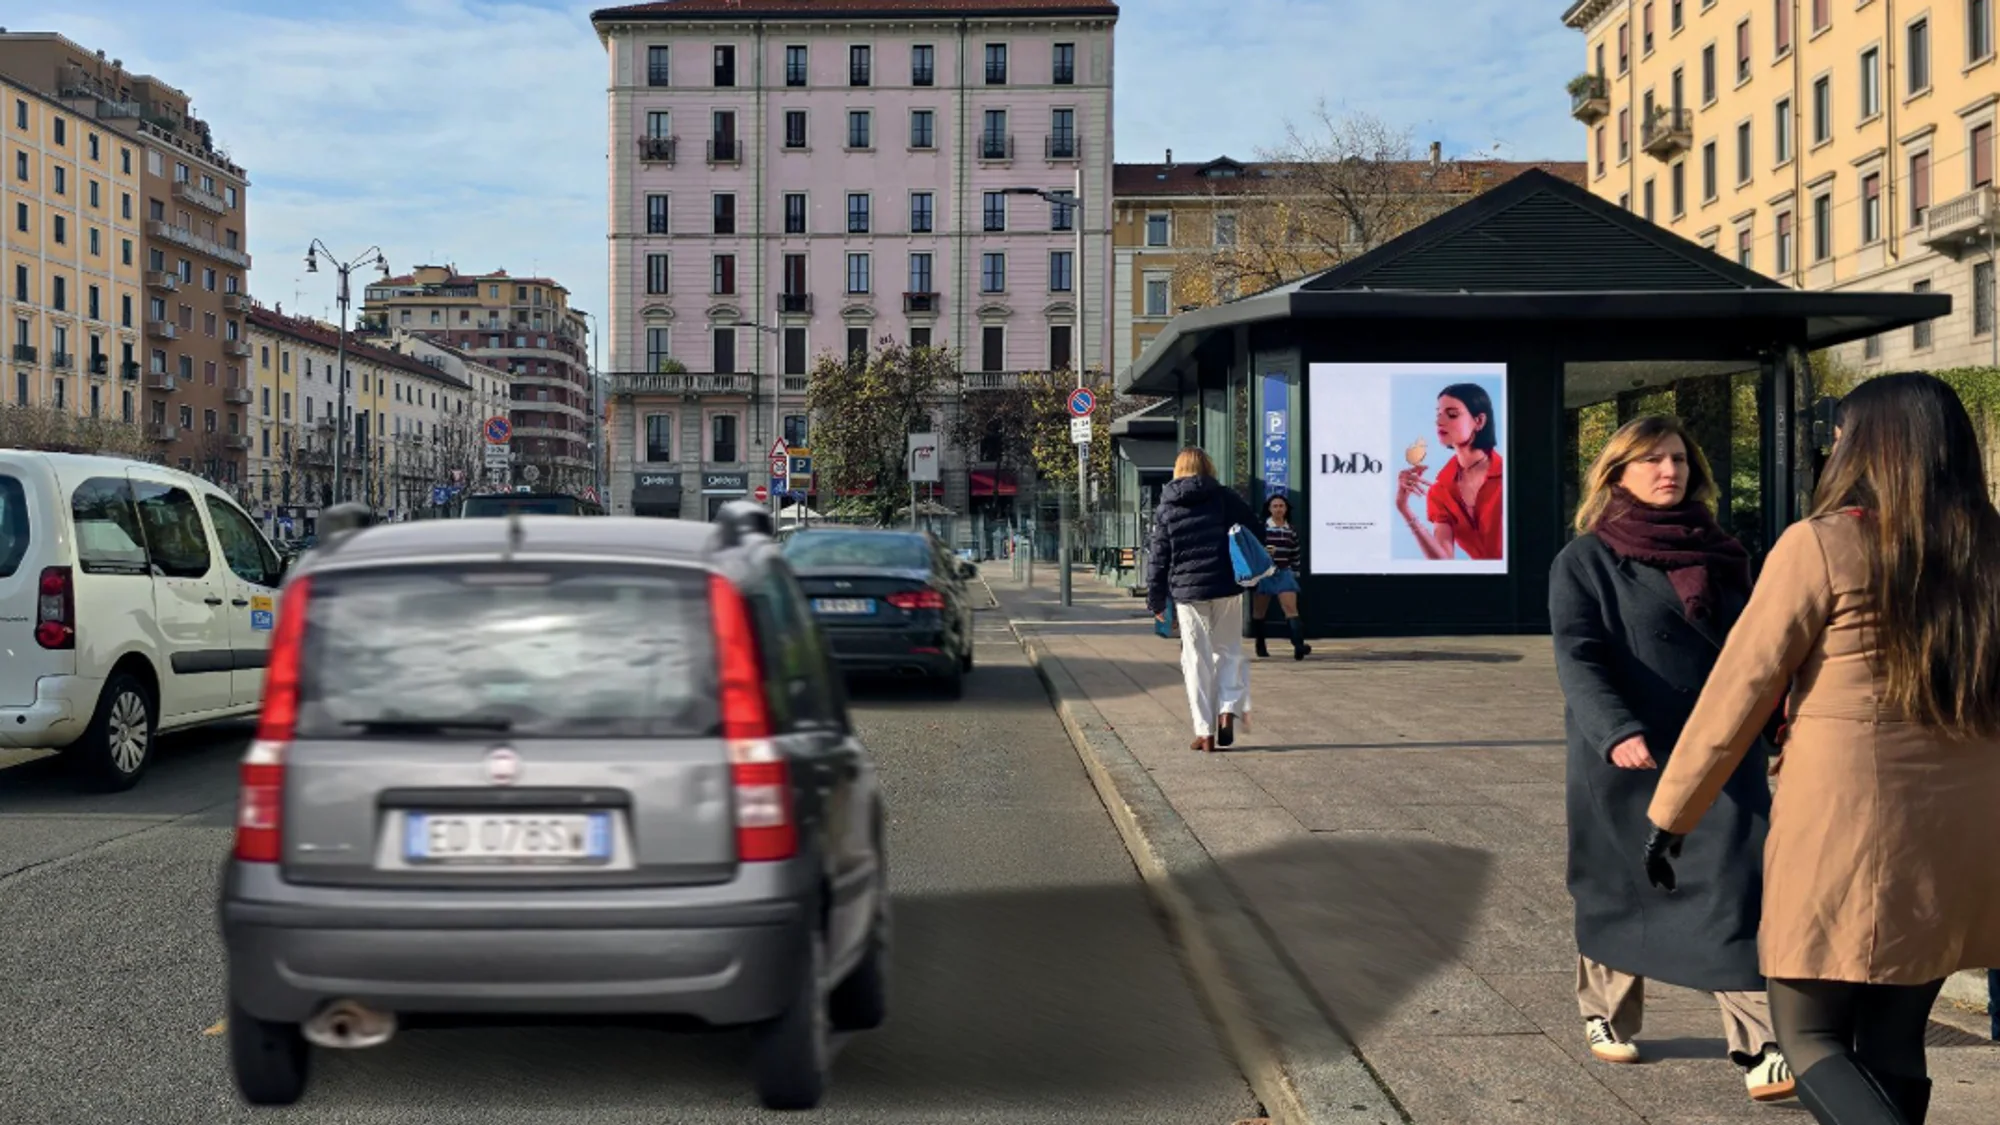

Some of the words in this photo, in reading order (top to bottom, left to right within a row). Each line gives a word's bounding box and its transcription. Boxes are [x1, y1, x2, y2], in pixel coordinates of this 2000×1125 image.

[1271, 417, 1282, 432] P
[797, 459, 806, 471] P
[1321, 452, 1383, 474] DoDo
